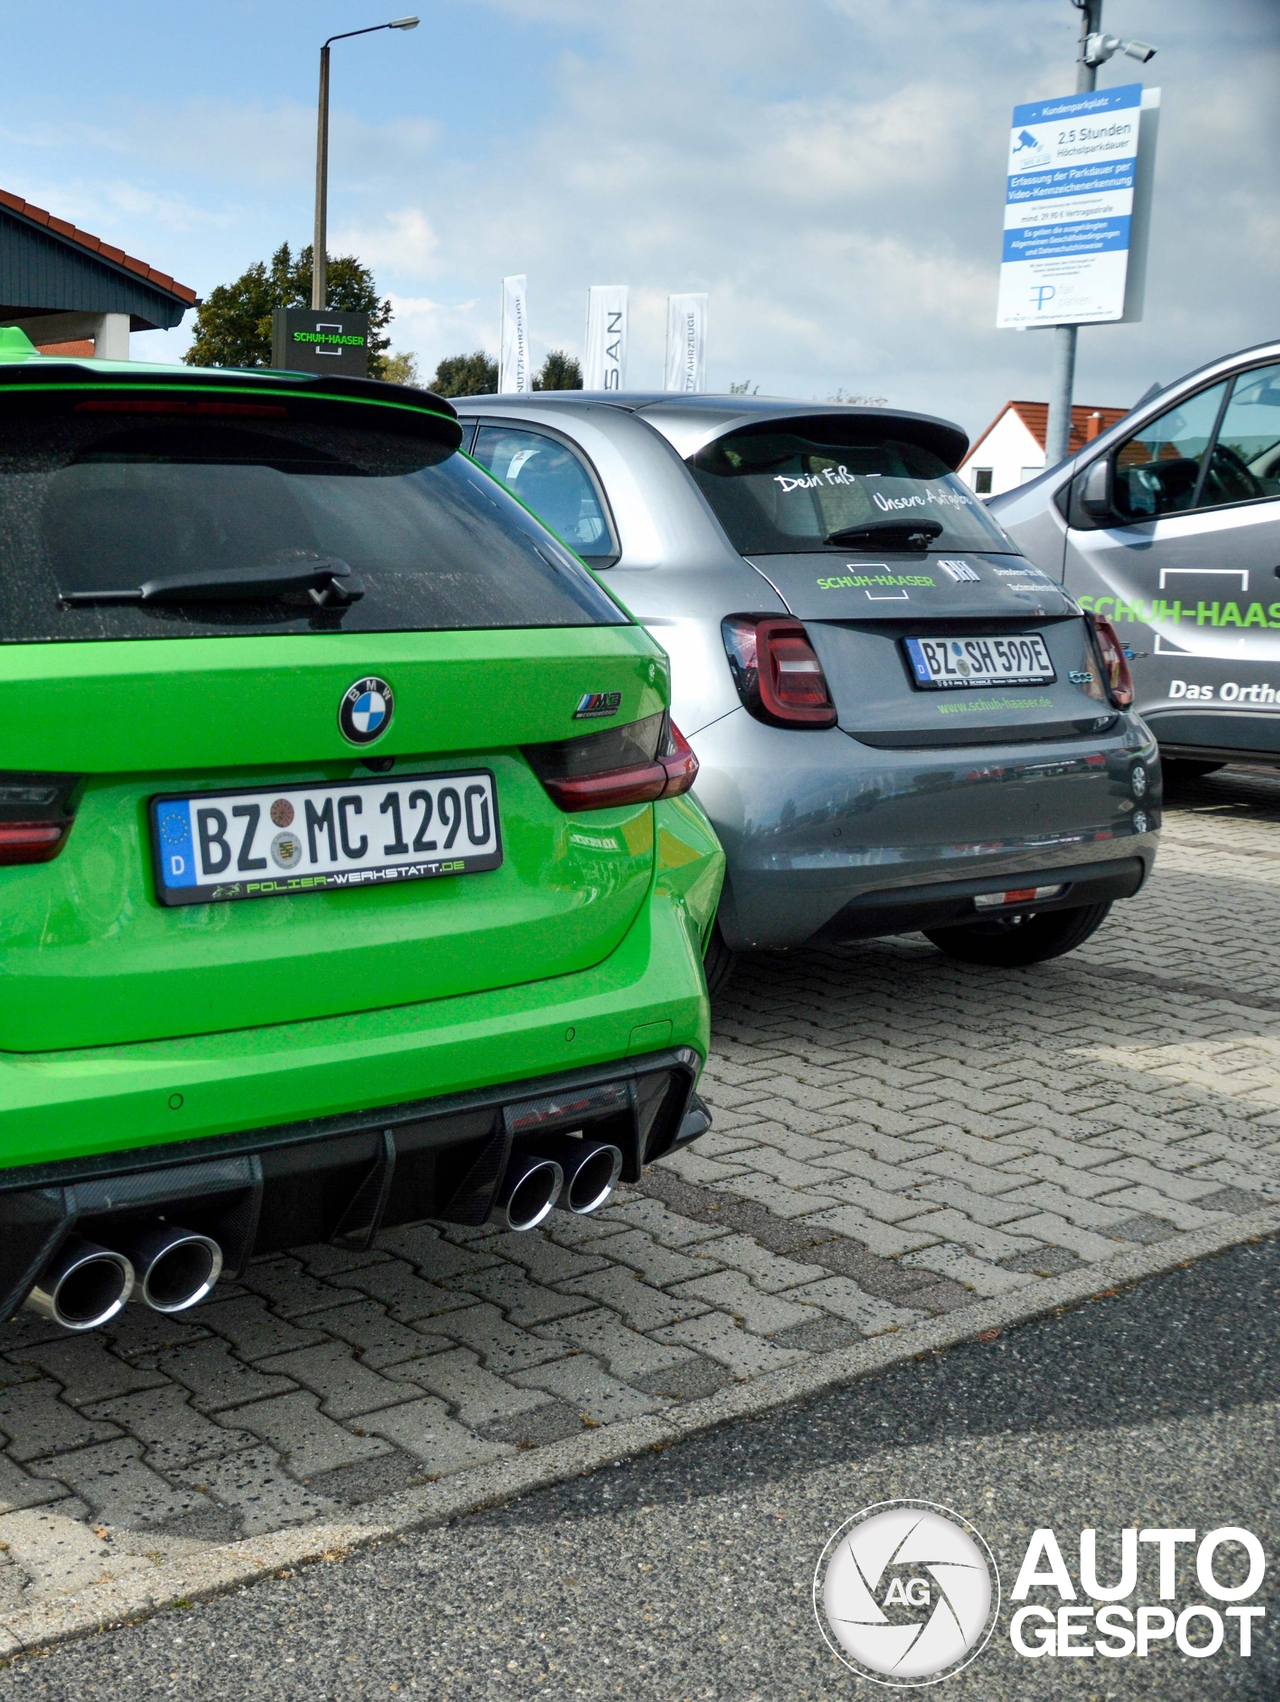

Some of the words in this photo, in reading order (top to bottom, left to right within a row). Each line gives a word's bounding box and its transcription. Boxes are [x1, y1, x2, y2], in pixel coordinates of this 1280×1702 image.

[1042, 97, 1110, 116] Kundenparkplatz
[1079, 123, 1131, 141] Stunden
[1057, 140, 1130, 157] Höchstparkdauer
[1011, 174, 1052, 187] Erfassung
[1053, 171, 1069, 181] der
[1068, 165, 1115, 179] Parkdauer
[1115, 163, 1133, 174] per
[1008, 176, 1133, 199] Video-Kennzeichenerkennung
[1025, 248, 1038, 257] und
[293, 331, 365, 346] SCHUH-HAASER
[774, 473, 823, 492] Dein
[822, 465, 856, 486] Fuß
[873, 492, 926, 512] Unsere
[926, 488, 973, 510] Aufgabe
[816, 575, 936, 590] SCHUH-HAASER
[922, 642, 957, 675] BZ
[965, 641, 997, 673] SH
[993, 640, 1050, 672] 599E
[917, 664, 926, 674] D
[347, 680, 392, 702] BMW
[1168, 680, 1214, 700] Das
[937, 697, 1054, 714] www.schuh-haaser.de
[197, 803, 268, 876] BZ
[304, 794, 369, 864] MC
[379, 783, 492, 856] 1290
[170, 855, 185, 876] D
[247, 860, 465, 894] POLIER-WERKSTATT.DE
